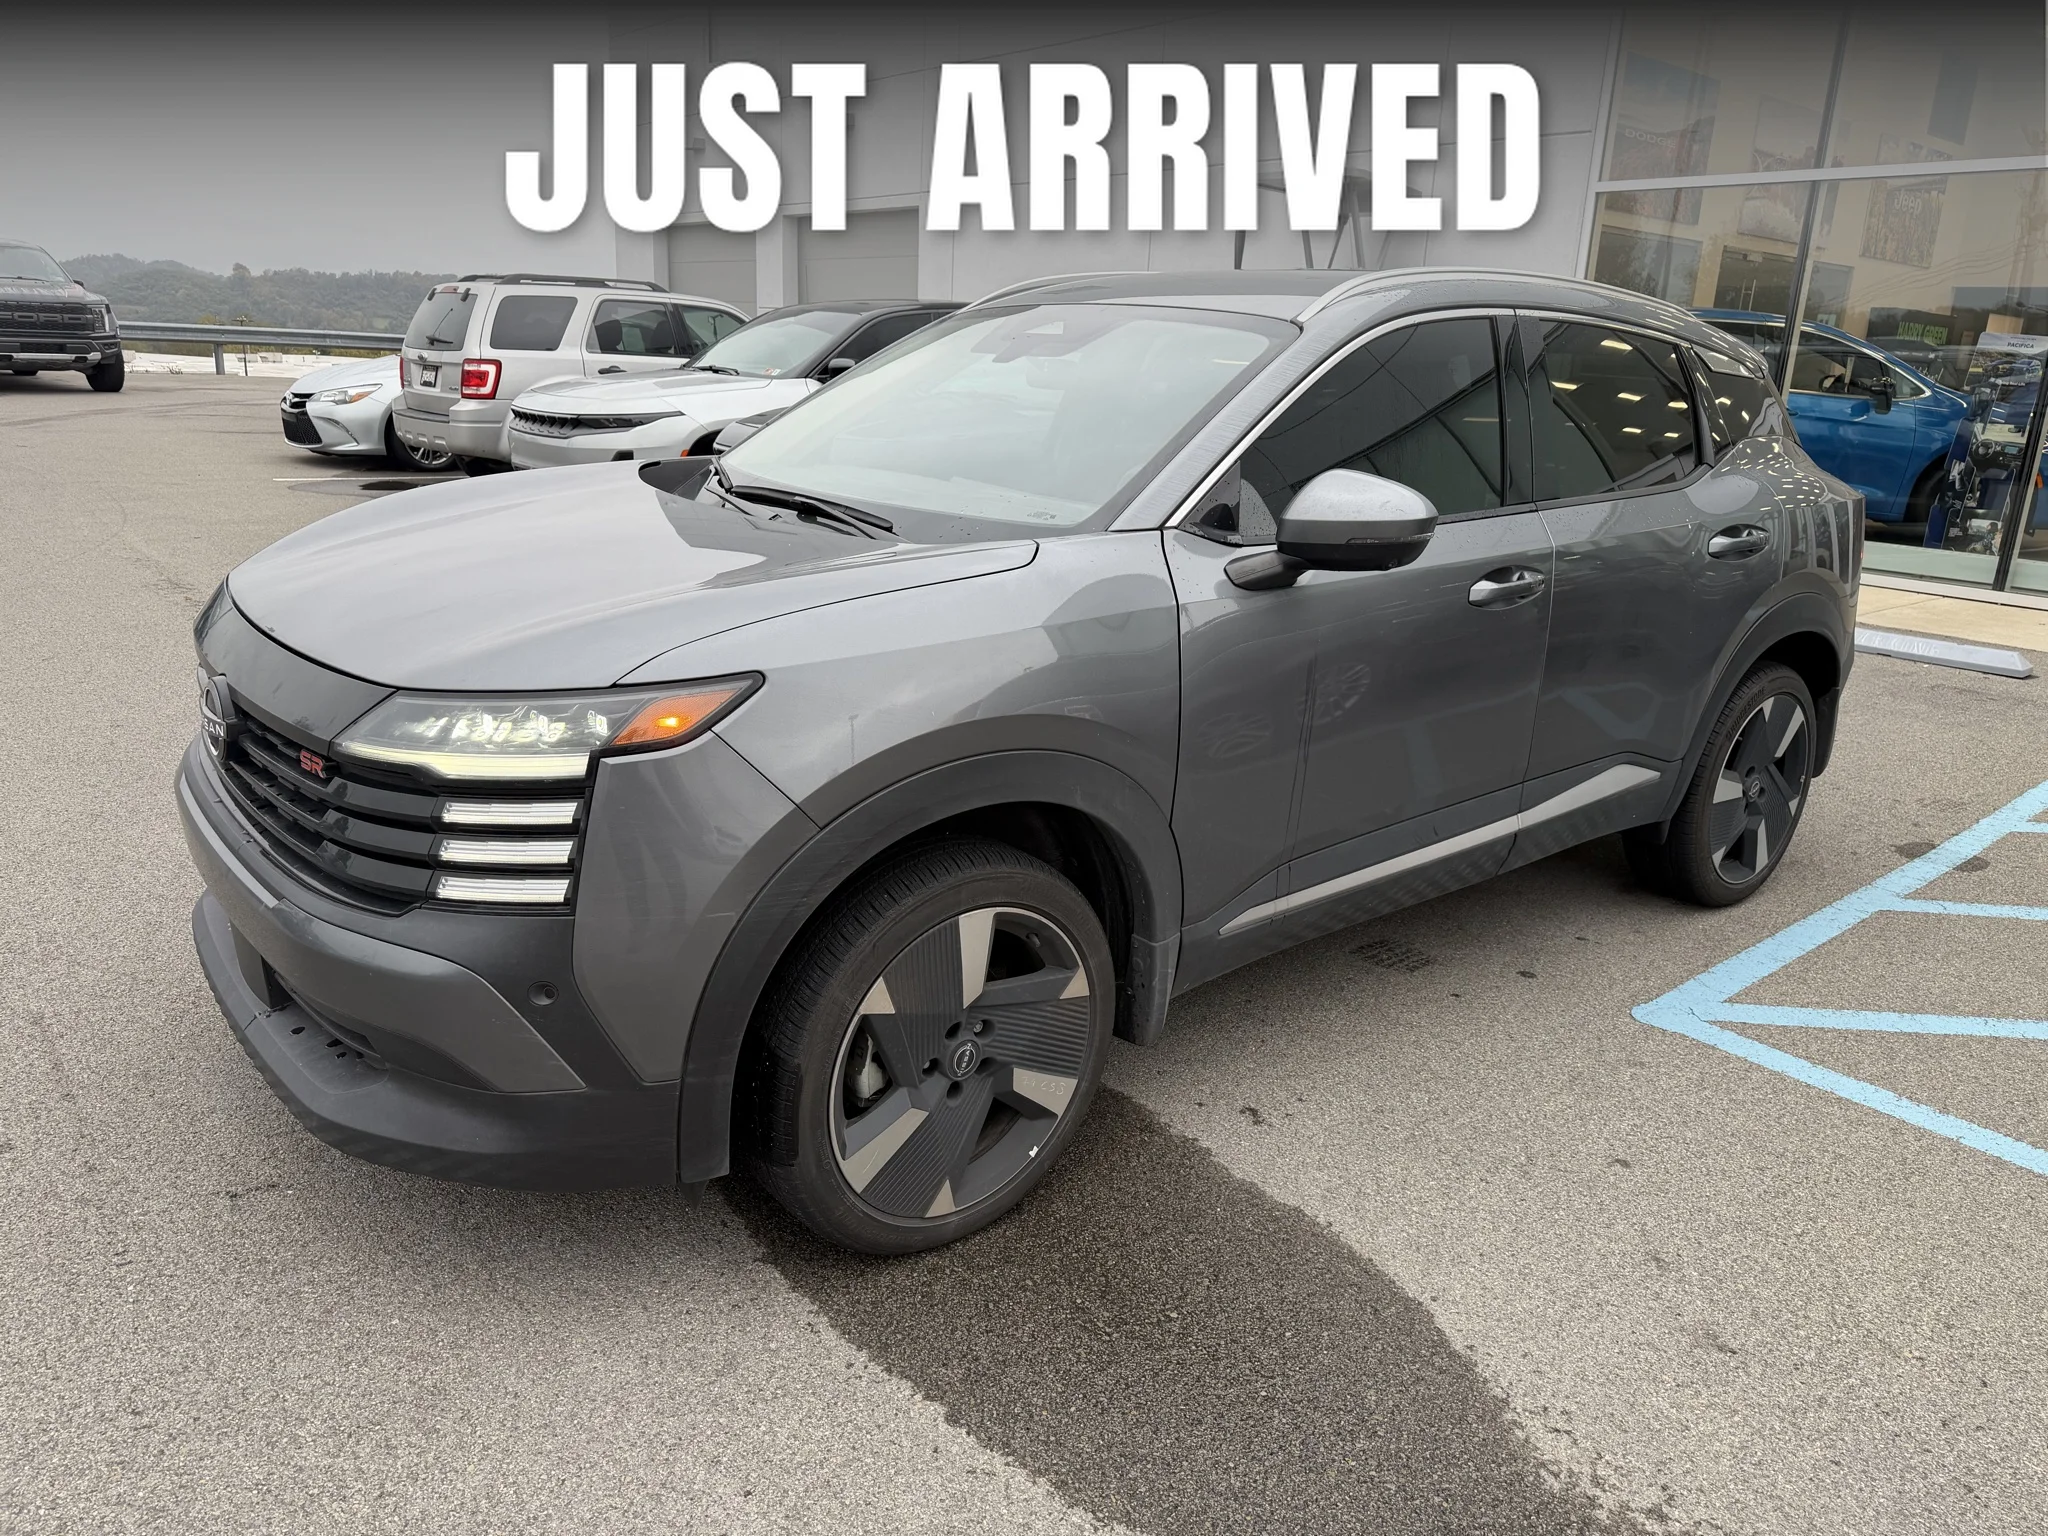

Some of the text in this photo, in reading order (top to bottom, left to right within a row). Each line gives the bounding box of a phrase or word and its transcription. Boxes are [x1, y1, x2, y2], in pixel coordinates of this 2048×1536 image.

[1625, 128, 1676, 148] DODGE
[1894, 190, 1922, 218] Jeep
[1897, 321, 1949, 345] HARRY GREEN
[2006, 341, 2035, 349] PACIFICA
[1725, 686, 1766, 738] BRIDGESTONE
[300, 749, 326, 778] SR
